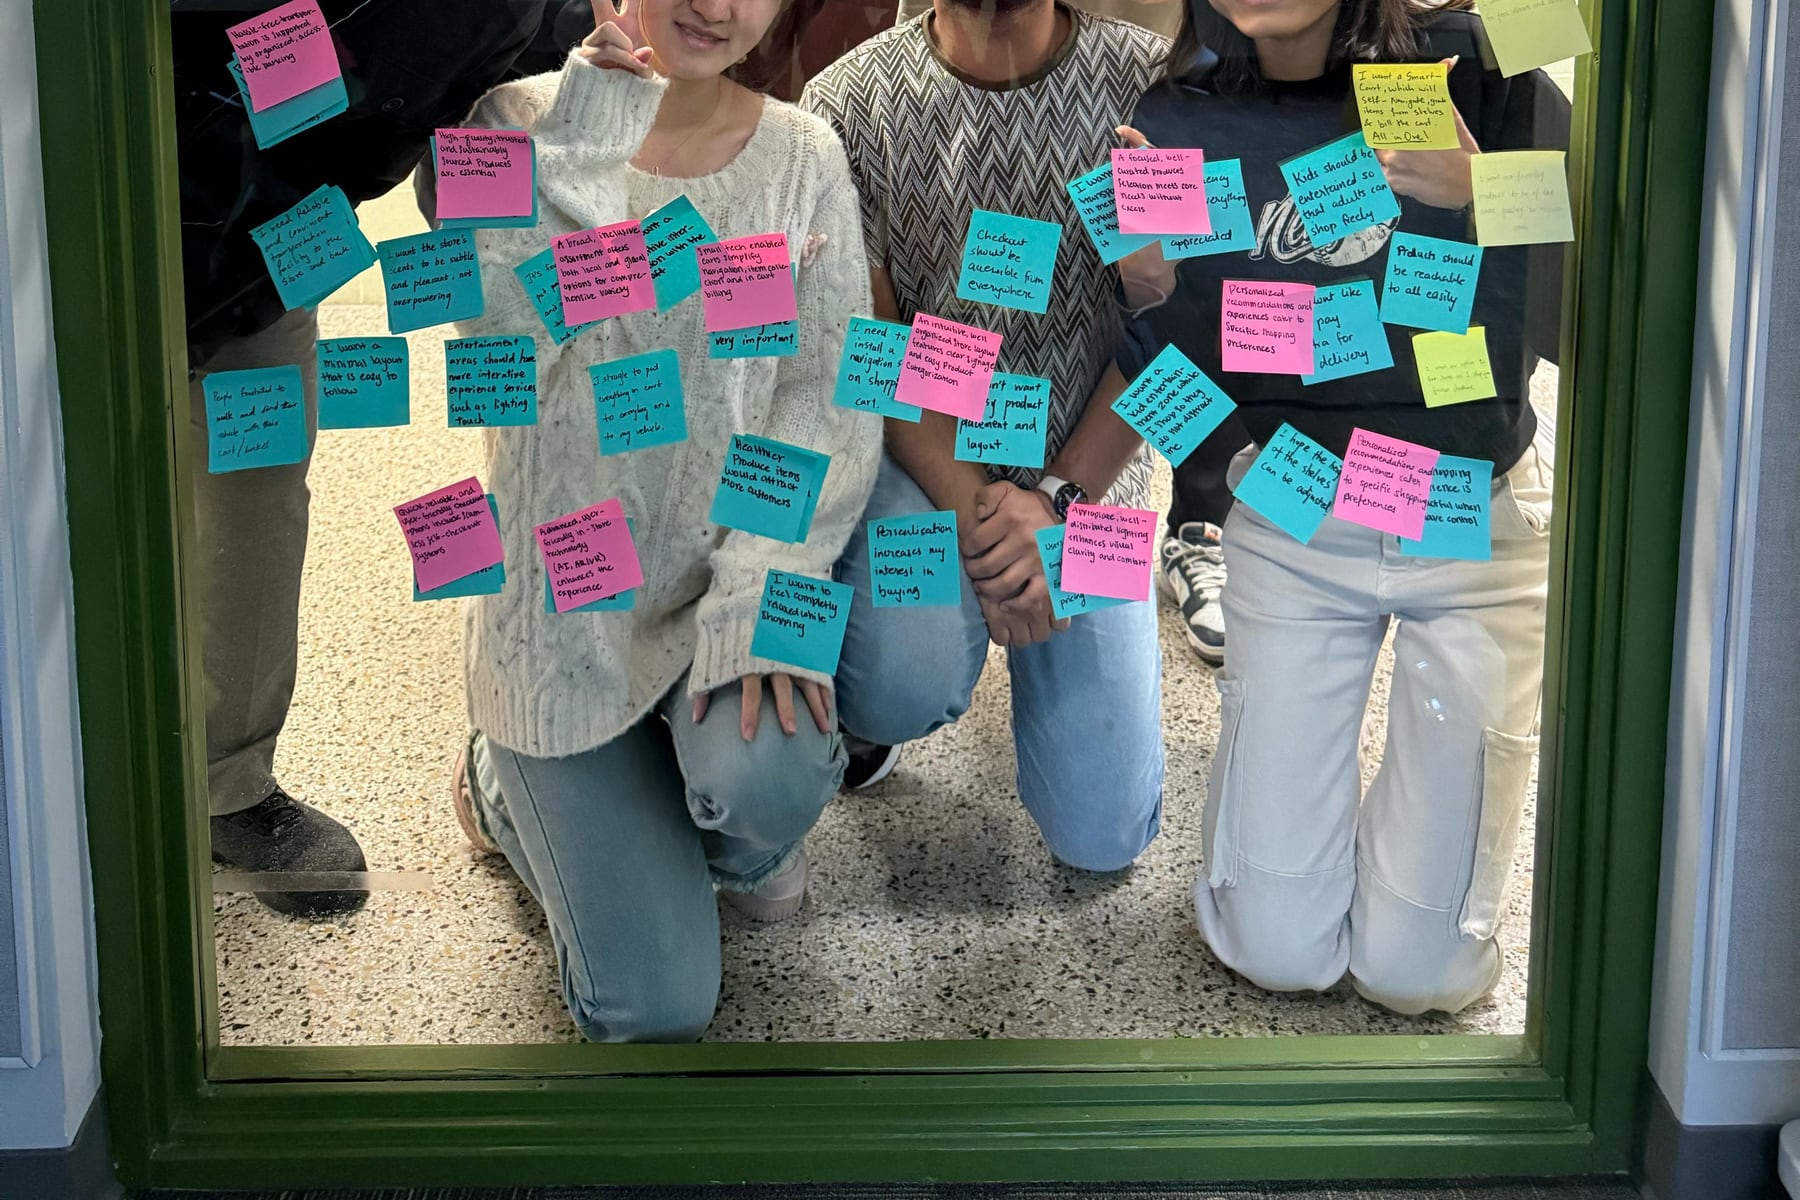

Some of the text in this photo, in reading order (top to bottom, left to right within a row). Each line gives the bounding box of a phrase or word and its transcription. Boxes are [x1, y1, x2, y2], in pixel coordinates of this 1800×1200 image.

[1292, 148, 1373, 184] Kids should be
[1298, 170, 1375, 204] entertained so
[1302, 183, 1388, 219] that adults can
[1310, 210, 1376, 236] shop freely
[976, 229, 1028, 246] Checkout
[968, 245, 1020, 263] should be
[1396, 245, 1474, 267] Products should
[1024, 270, 1044, 284] from
[1393, 265, 1465, 286] be reachable
[967, 280, 1035, 299] everywhere
[1388, 284, 1458, 312] to all easily
[322, 342, 332, 353] I
[337, 341, 366, 351] want
[323, 356, 404, 371] minimal layout
[322, 371, 398, 386] that is easy to
[323, 385, 358, 396] follow
[725, 465, 798, 491] would attract
[776, 465, 800, 482] items
[721, 476, 791, 508] more customers
[873, 546, 945, 562] increases my
[874, 564, 935, 577] interest in
[878, 583, 920, 603] buying
